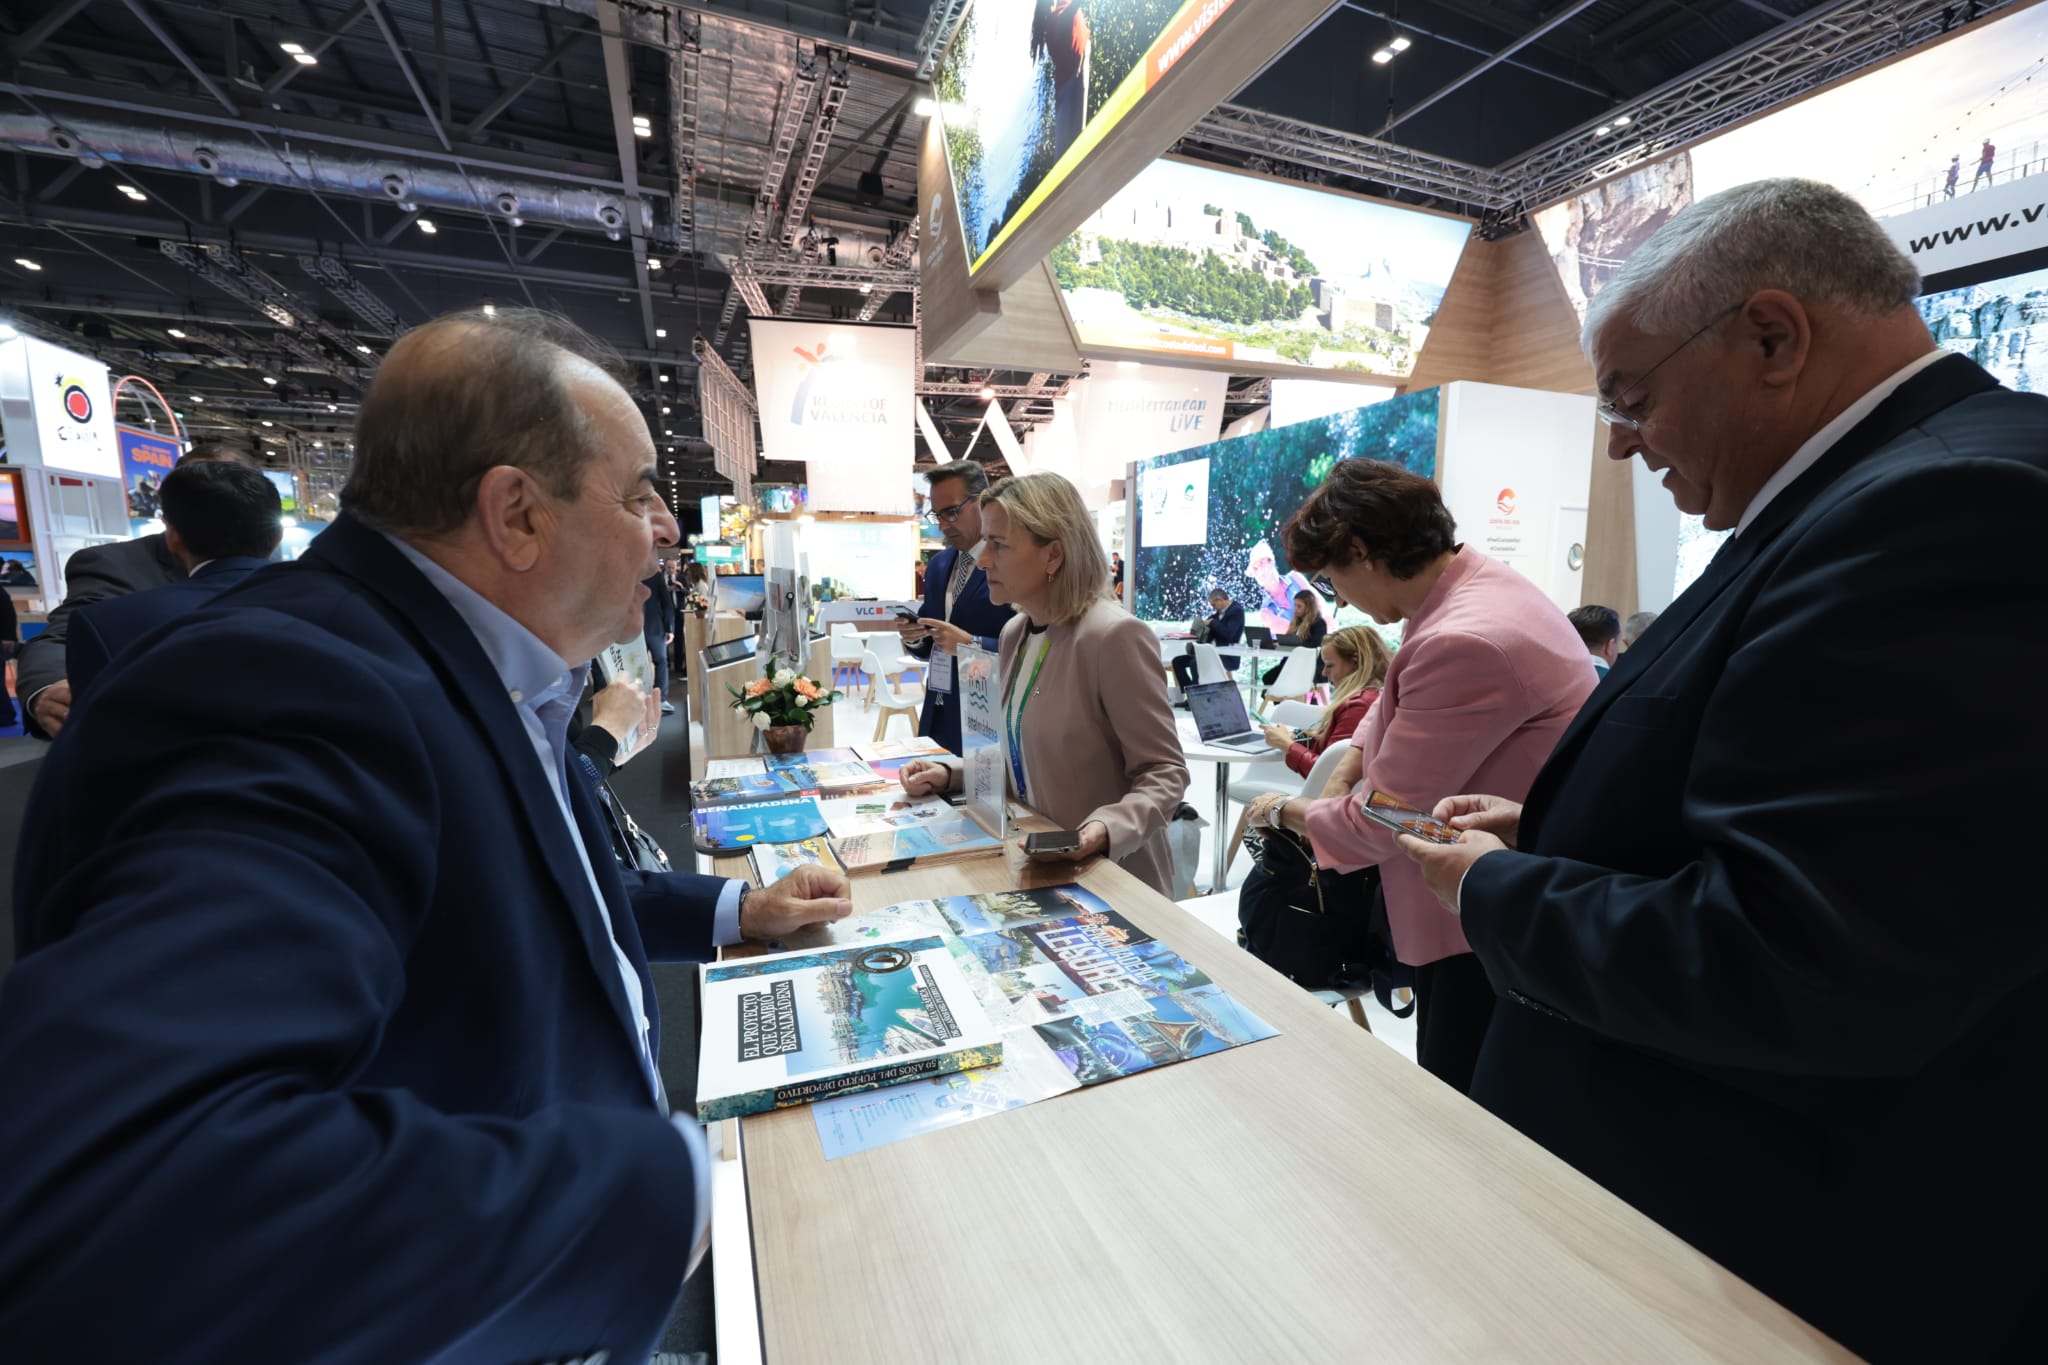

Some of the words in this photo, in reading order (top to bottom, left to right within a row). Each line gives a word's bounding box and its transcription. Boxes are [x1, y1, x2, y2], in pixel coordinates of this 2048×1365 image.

[1909, 202, 2048, 254] www.v
[870, 398, 887, 410] OF
[810, 409, 888, 424] VALENCIA
[855, 607, 875, 616] VLC
[743, 994, 759, 1044] PROYECTO
[743, 1043, 760, 1059] EL
[762, 1031, 782, 1056] QUE
[837, 1073, 877, 1089] PUERTO
[880, 1068, 897, 1080] DEL
[777, 1080, 836, 1100] DEPORTIVO
